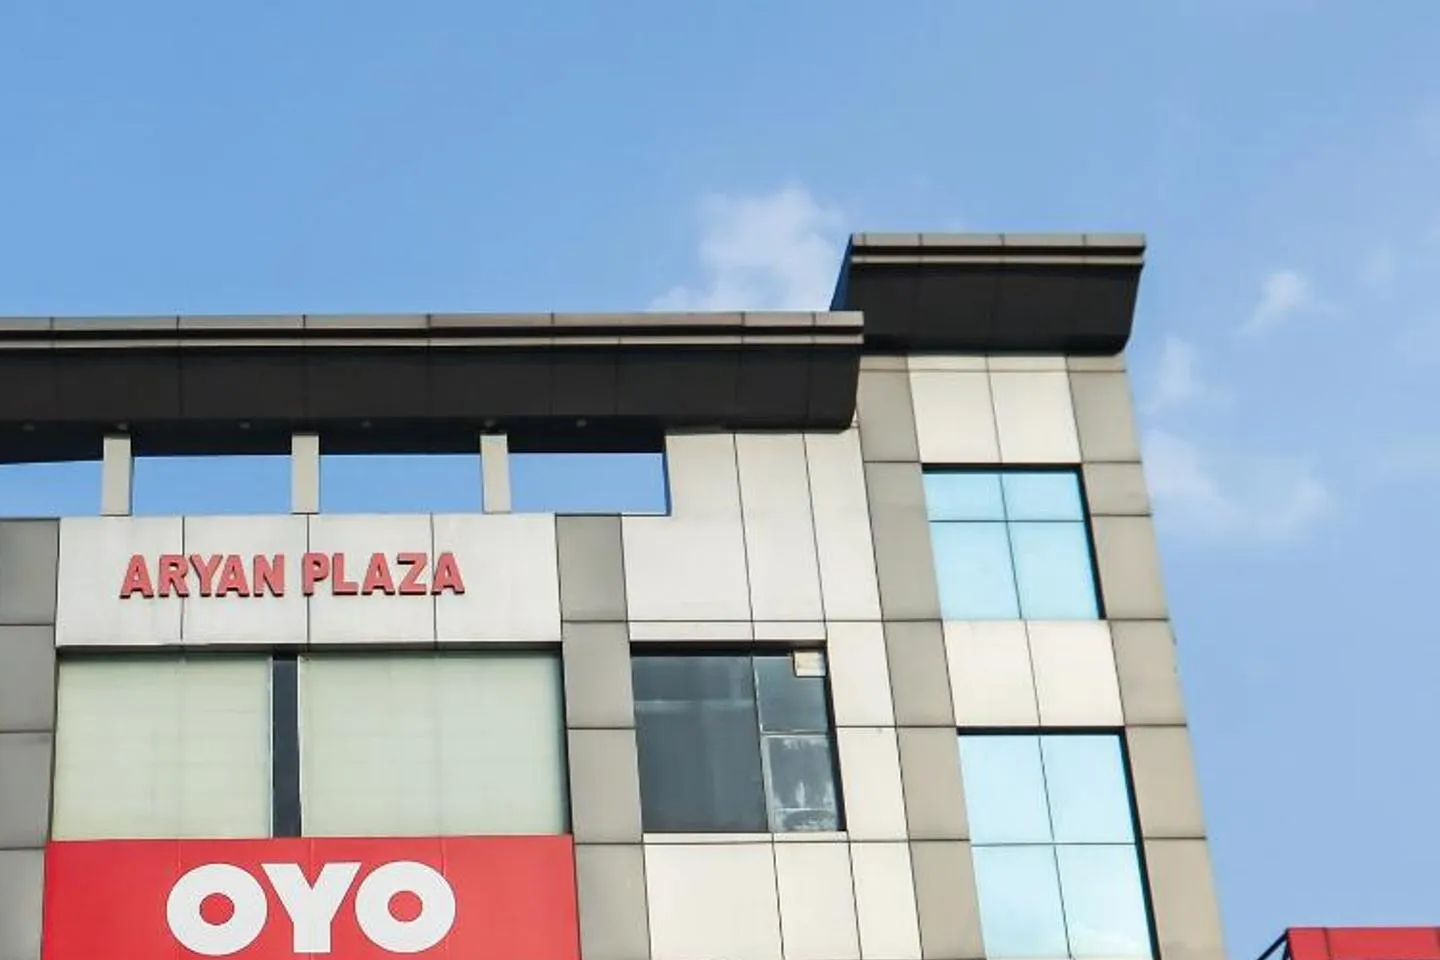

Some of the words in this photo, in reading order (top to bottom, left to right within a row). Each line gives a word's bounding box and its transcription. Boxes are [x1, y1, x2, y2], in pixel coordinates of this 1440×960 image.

[119, 553, 286, 598] ARYAN
[302, 551, 465, 597] PLAZA
[166, 860, 456, 956] OYO
